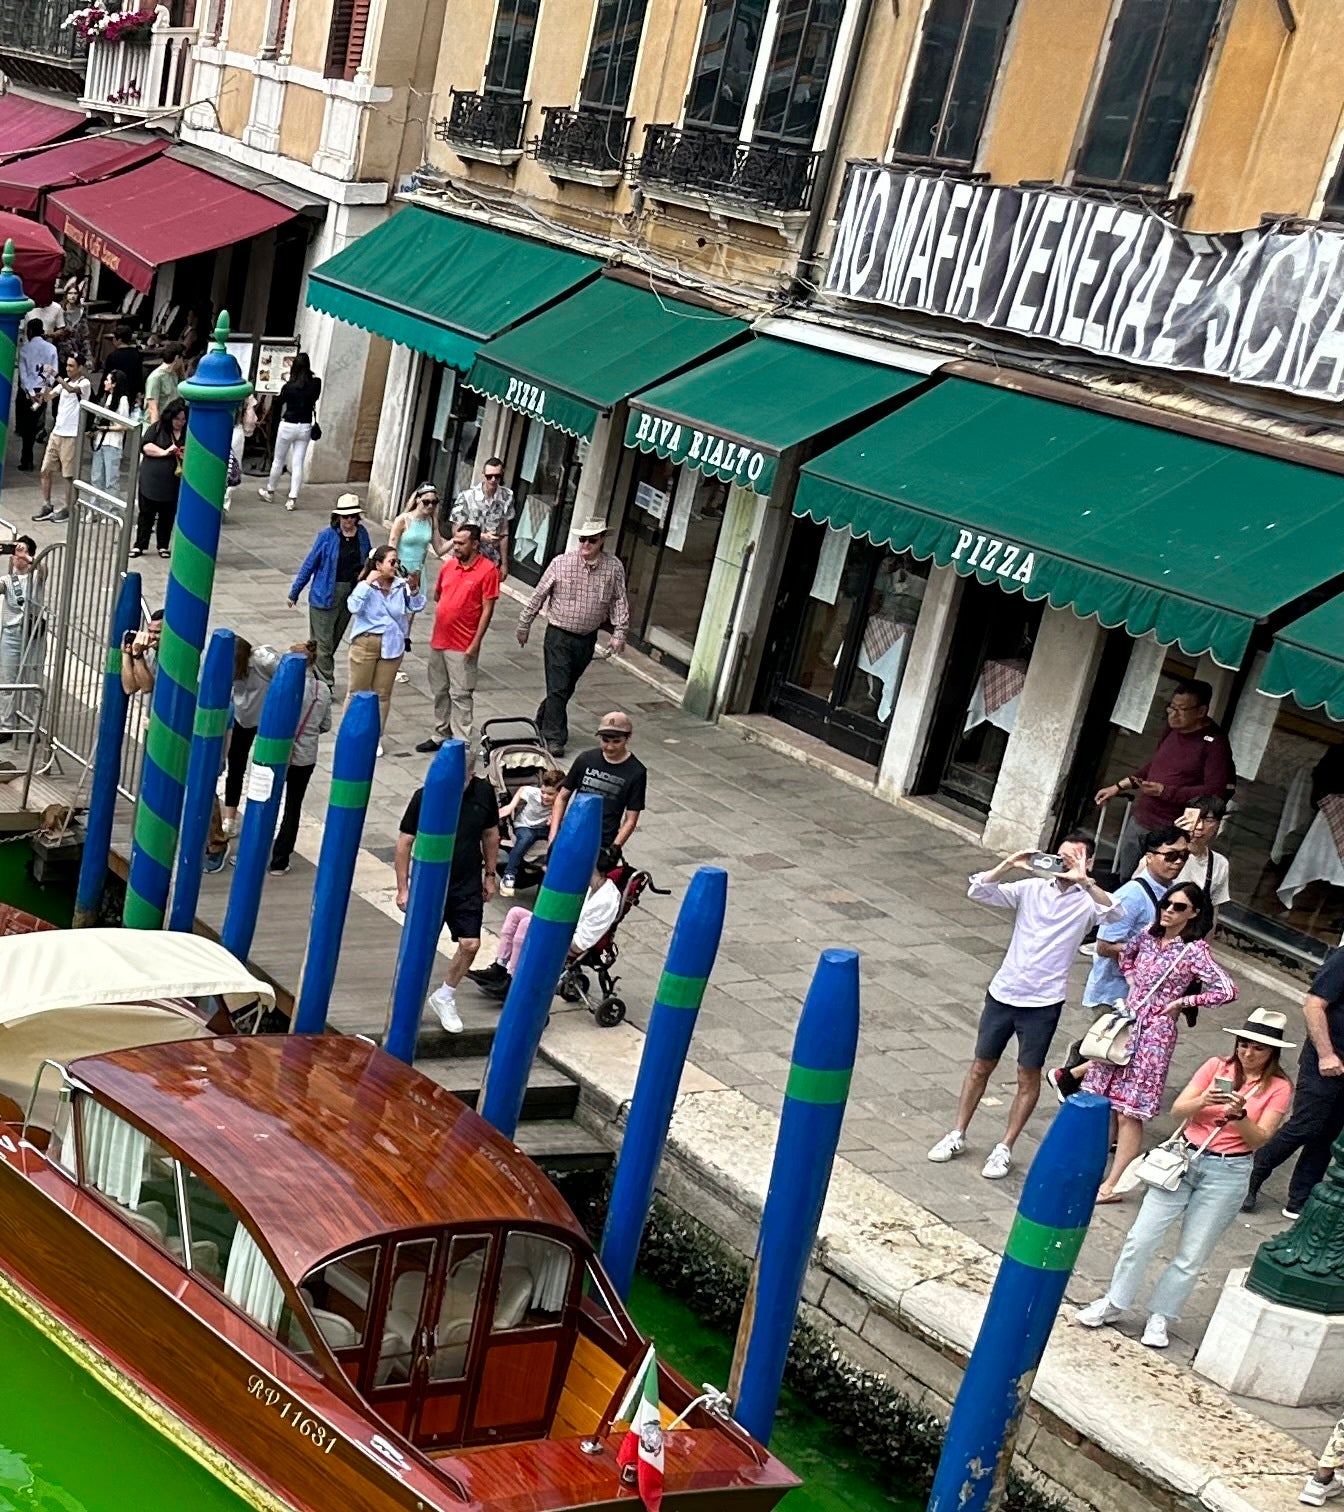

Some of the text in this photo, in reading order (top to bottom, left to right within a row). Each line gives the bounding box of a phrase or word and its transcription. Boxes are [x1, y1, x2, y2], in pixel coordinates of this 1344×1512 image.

[826, 169, 891, 296] NO
[875, 176, 1000, 318] MAFIA
[987, 192, 1175, 358] VENEZIA
[505, 377, 545, 415] PIZZA
[635, 413, 764, 480] RIVA RIALTO
[951, 529, 1034, 584] PIZZA
